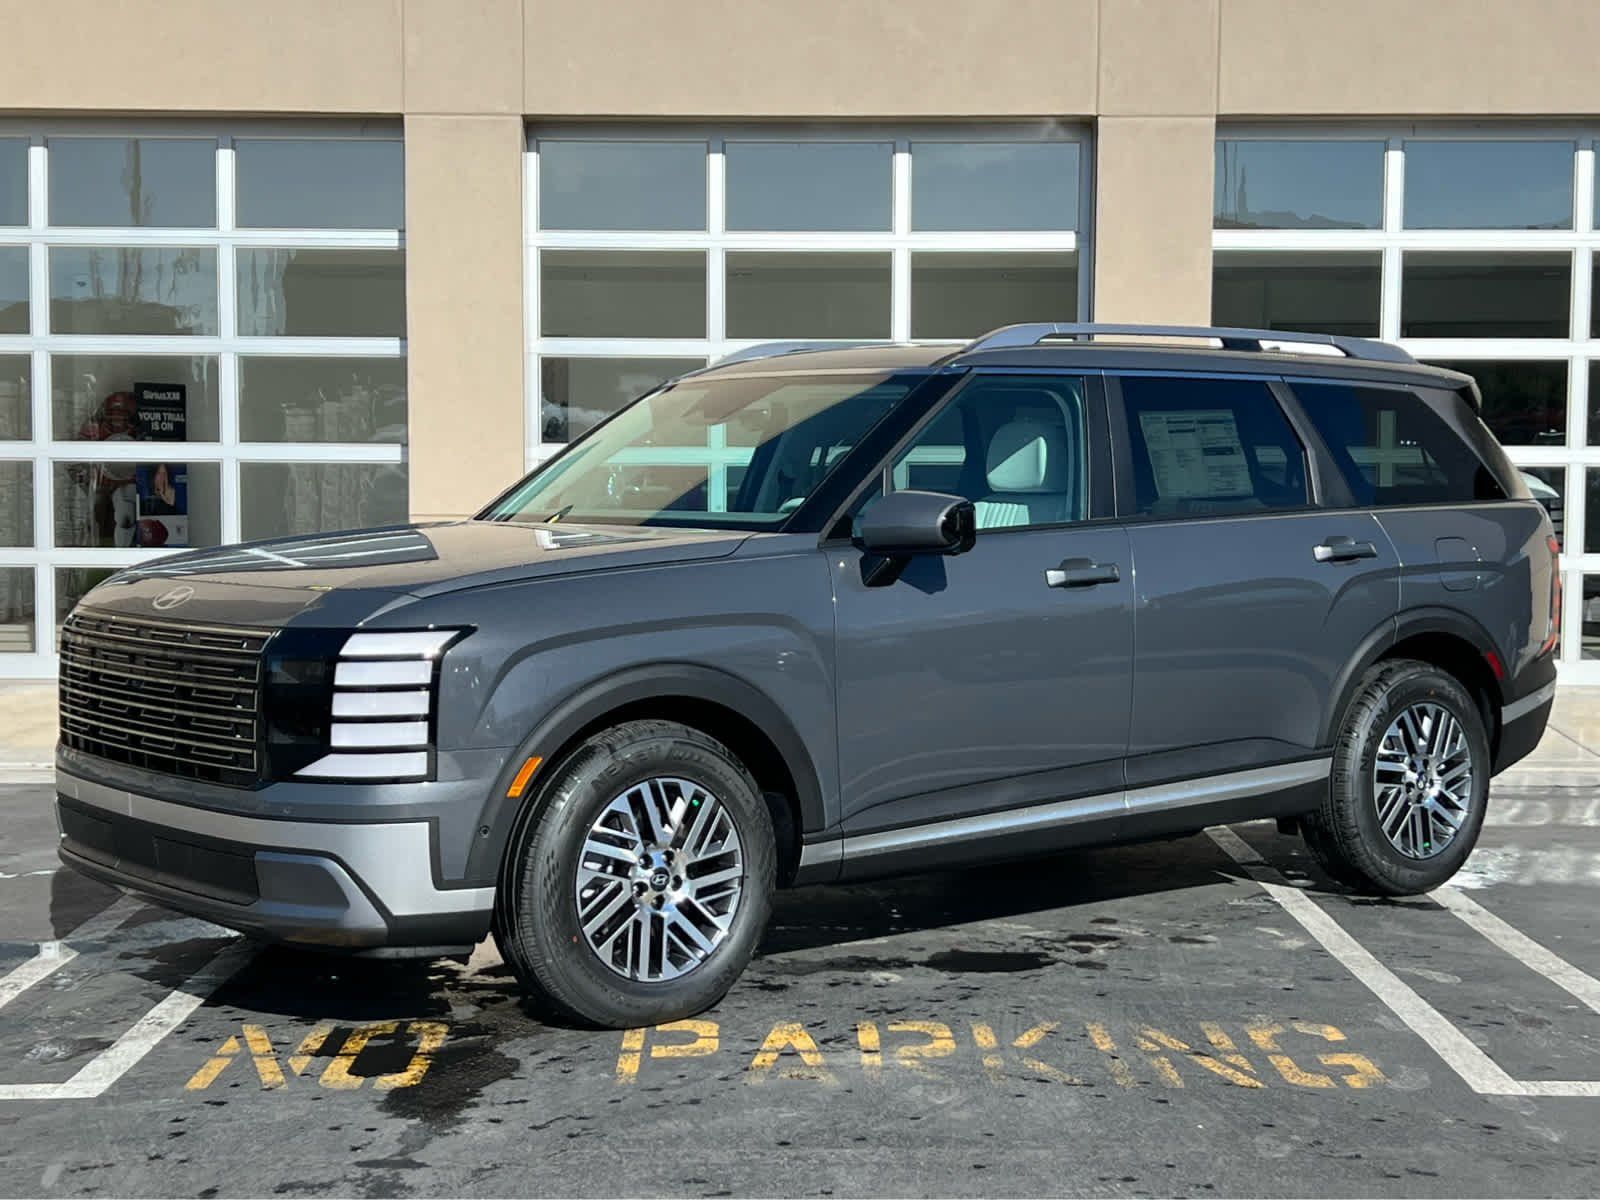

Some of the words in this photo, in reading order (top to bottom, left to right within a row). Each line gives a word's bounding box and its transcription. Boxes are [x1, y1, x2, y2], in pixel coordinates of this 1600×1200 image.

[138, 411, 161, 421] YOUR
[162, 412, 185, 422] TRIAL
[151, 421, 160, 431] IS
[160, 421, 174, 431] ON
[184, 1021, 450, 1092] NO
[616, 1019, 1390, 1092] PARKING
